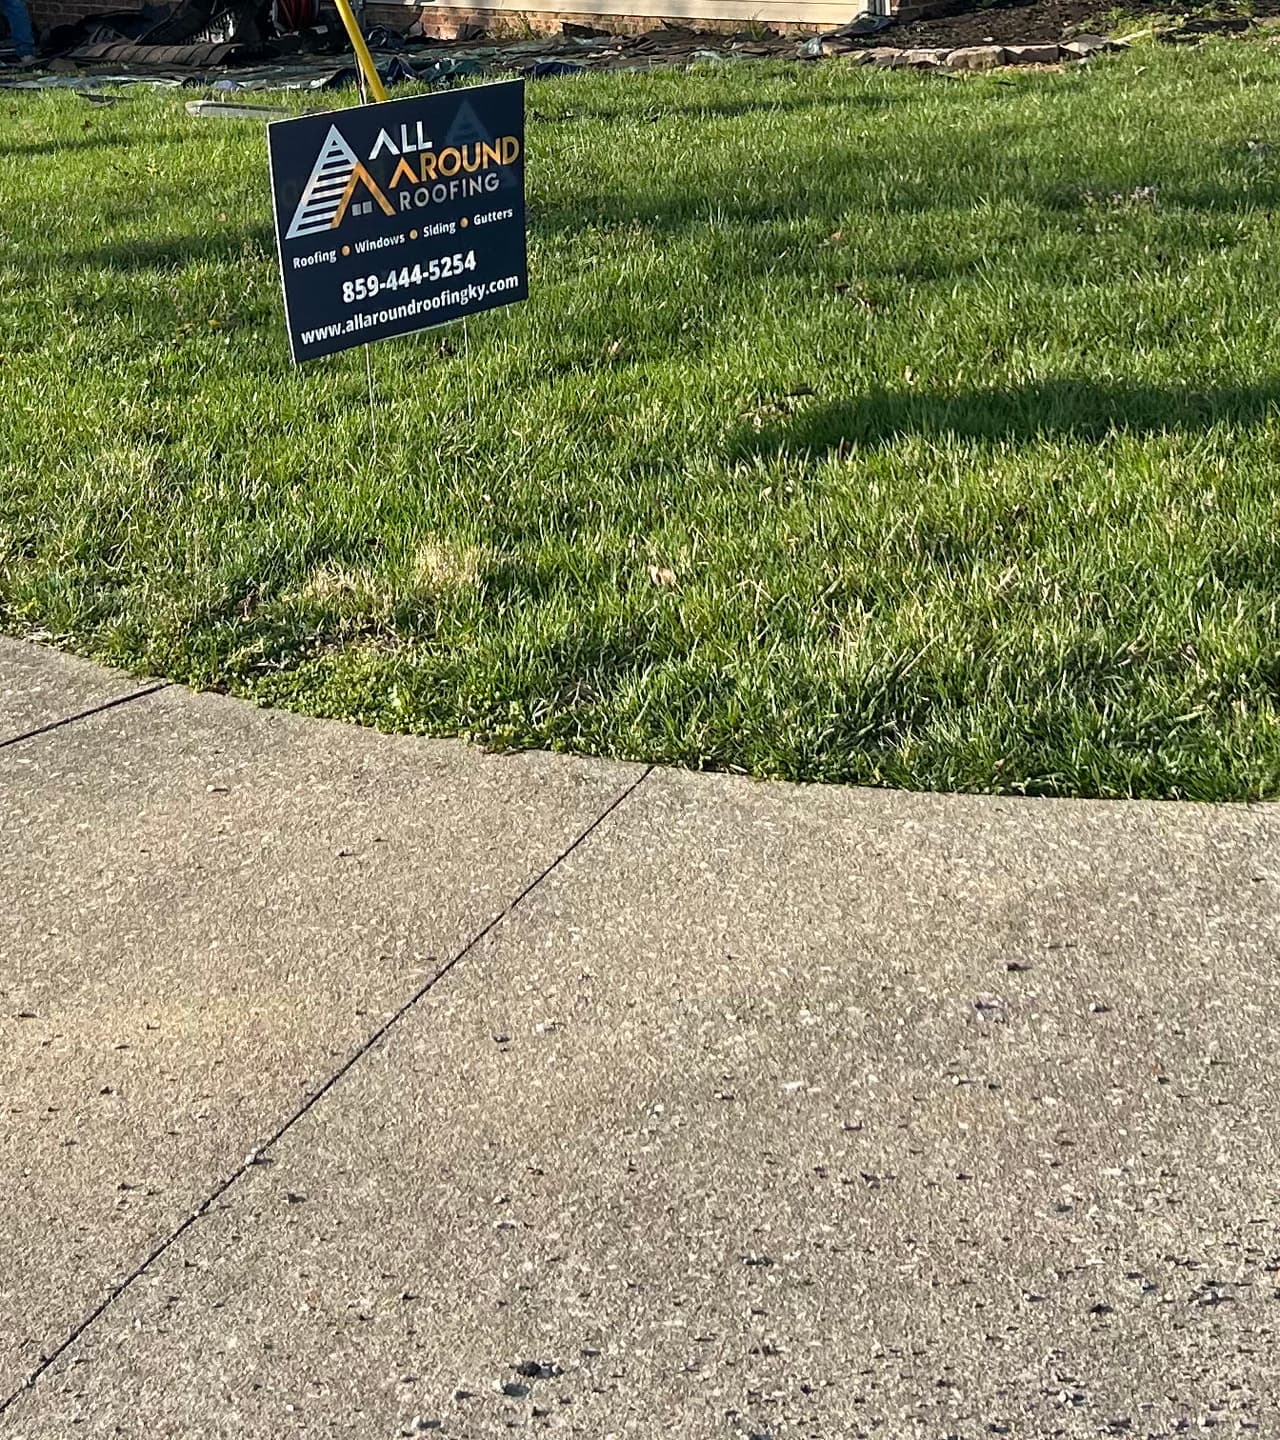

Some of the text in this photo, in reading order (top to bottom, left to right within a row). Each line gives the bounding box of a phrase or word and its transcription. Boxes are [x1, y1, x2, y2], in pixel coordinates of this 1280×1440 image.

[368, 120, 433, 160] ALL
[388, 135, 520, 189] AROUND
[399, 172, 500, 211] ROOFING
[292, 208, 514, 269] Roofing Windows Siding Gutters
[342, 249, 477, 303] 859-444-5254
[300, 274, 520, 345] www.allaroundroofingky.com
